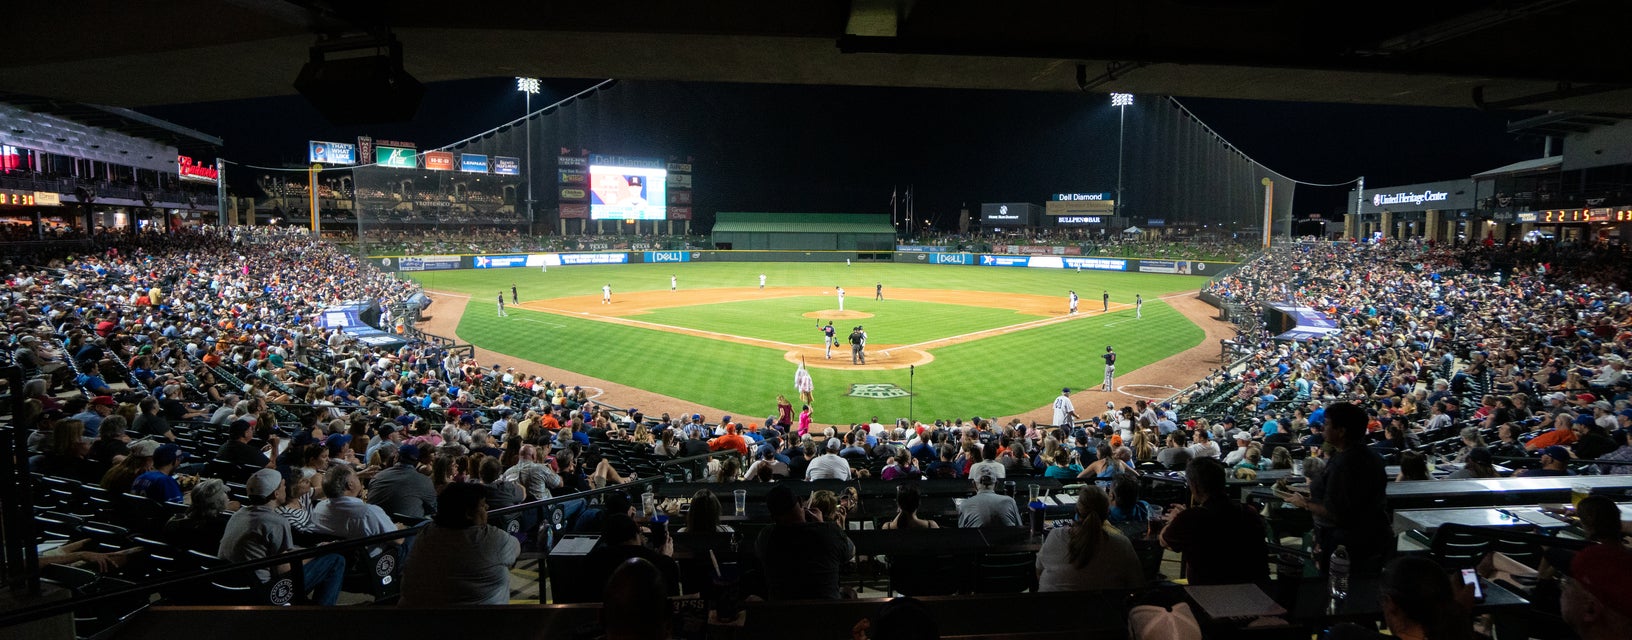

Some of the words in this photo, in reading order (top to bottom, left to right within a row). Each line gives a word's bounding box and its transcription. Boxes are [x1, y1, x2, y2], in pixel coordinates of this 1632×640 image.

[595, 155, 615, 166] Dell
[619, 156, 659, 167] Diamond
[1059, 193, 1072, 201] Dell
[1073, 193, 1102, 201] Diamond
[1380, 193, 1399, 205] United
[1399, 192, 1425, 205] Heritage
[1424, 190, 1448, 202] Center
